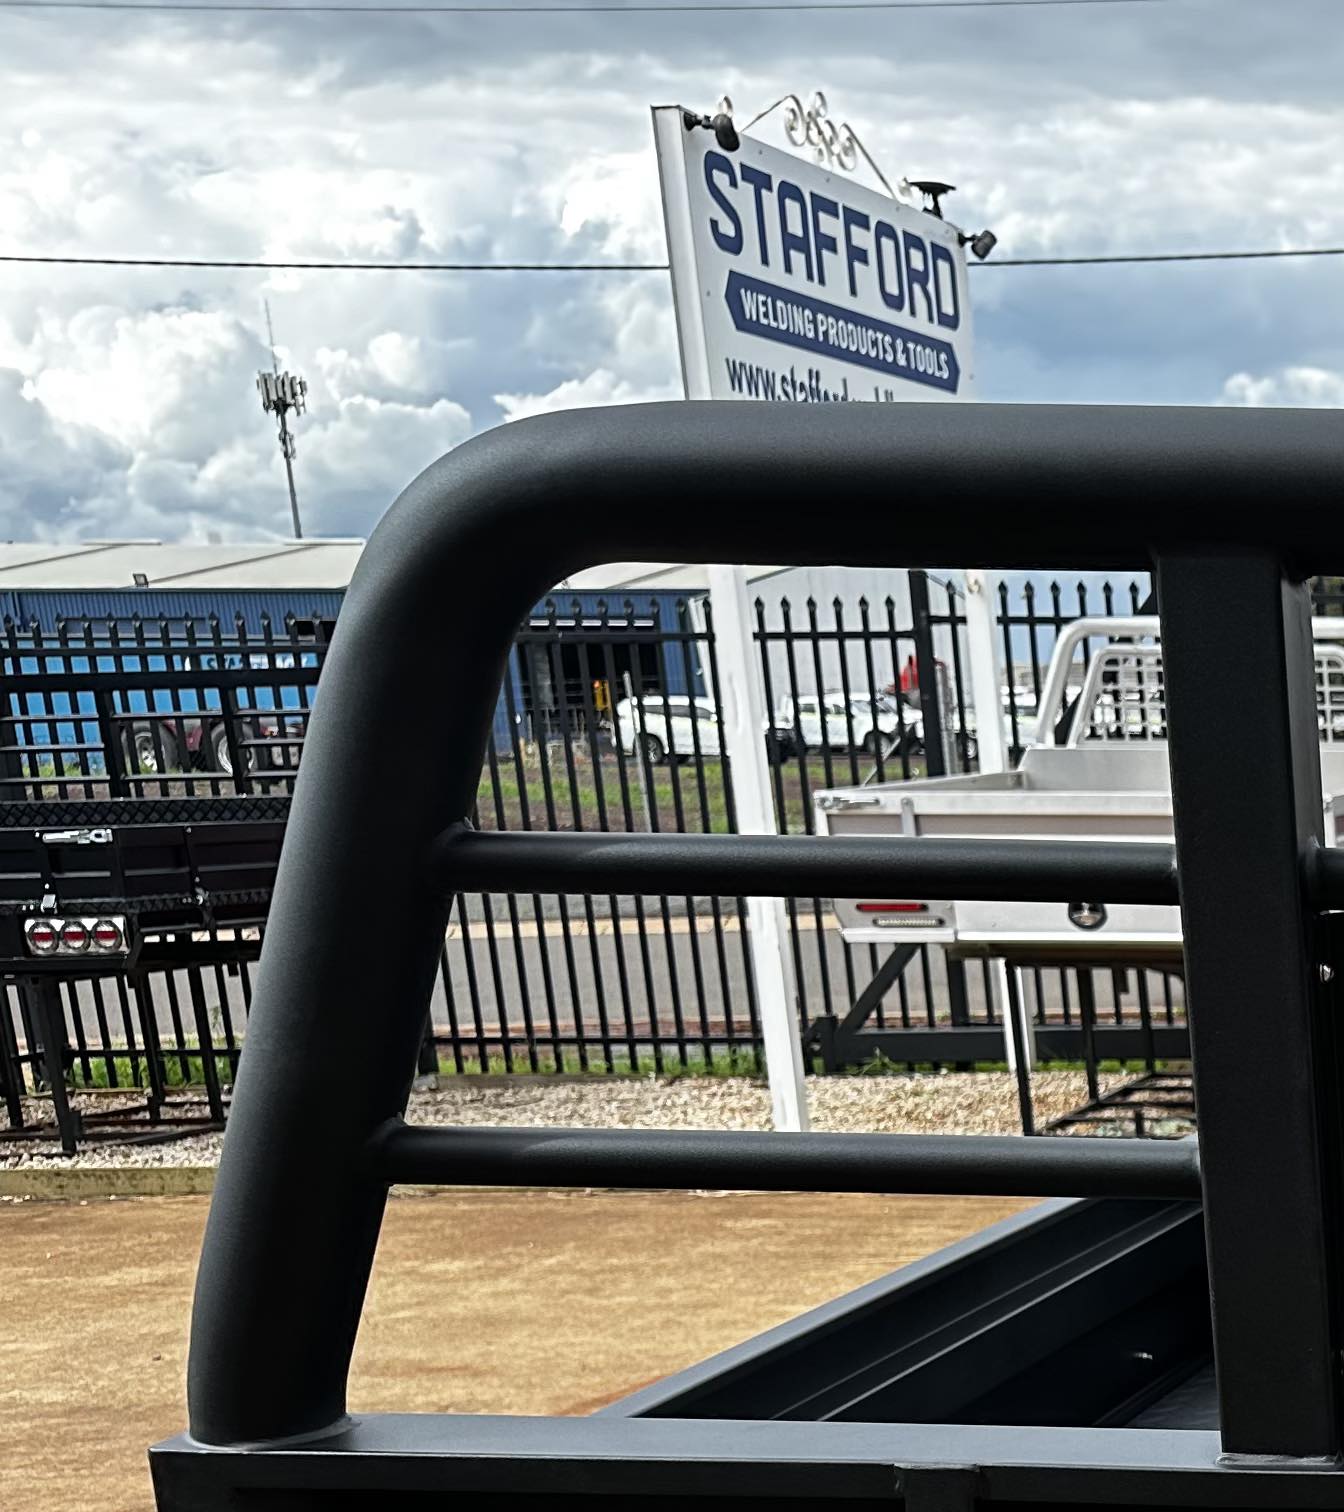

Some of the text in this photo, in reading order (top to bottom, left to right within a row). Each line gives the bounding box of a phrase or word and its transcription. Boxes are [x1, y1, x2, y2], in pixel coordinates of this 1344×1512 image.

[704, 150, 960, 330] STAFFORD
[740, 287, 950, 380] WELDING PRODUCTS & TOOLS
